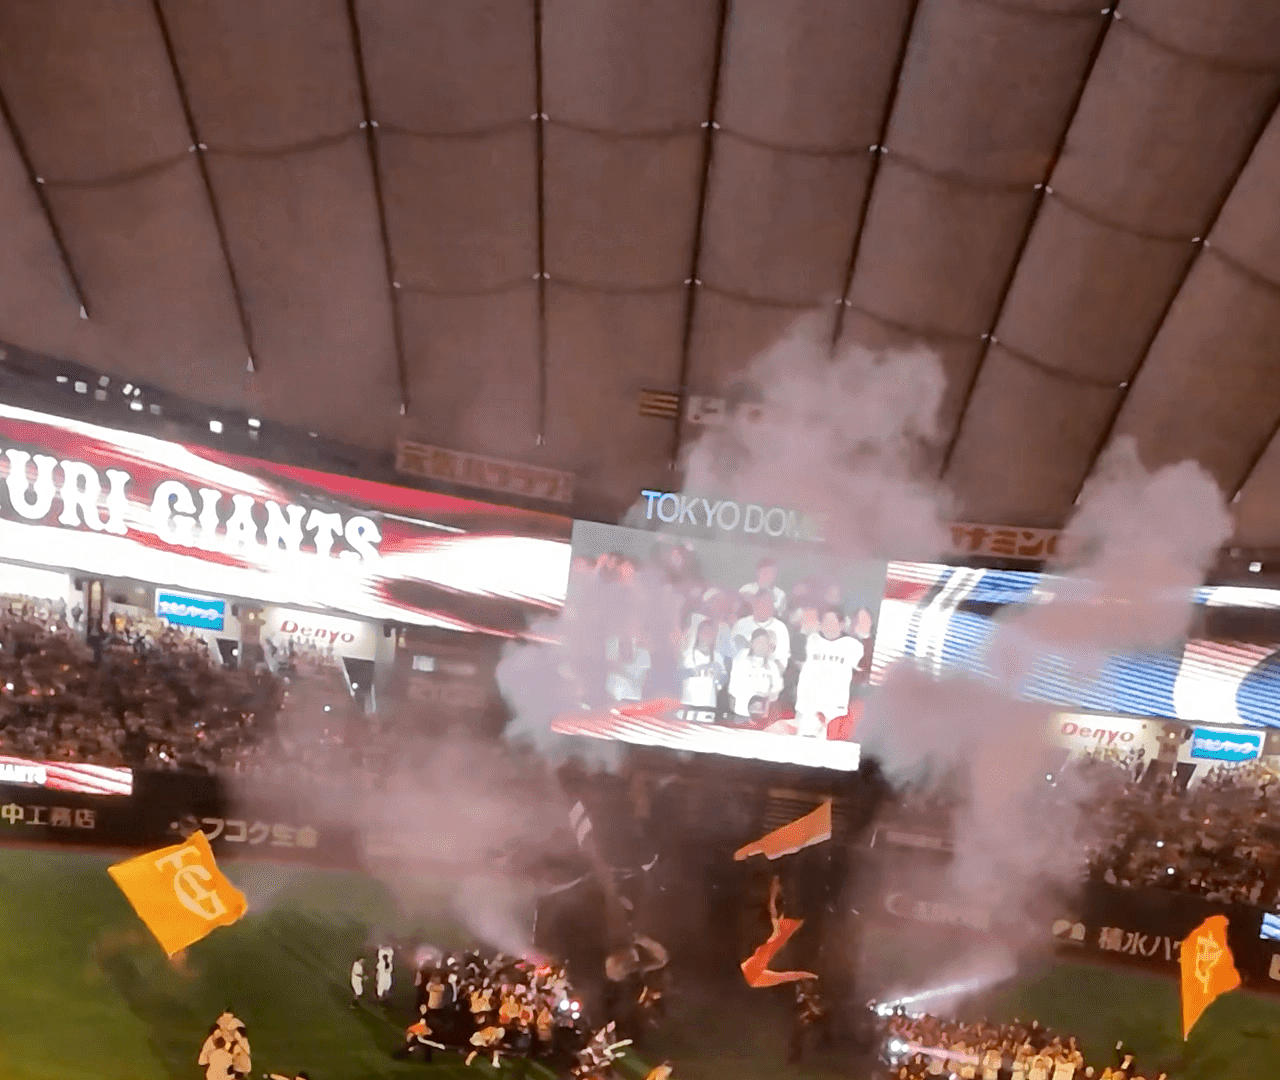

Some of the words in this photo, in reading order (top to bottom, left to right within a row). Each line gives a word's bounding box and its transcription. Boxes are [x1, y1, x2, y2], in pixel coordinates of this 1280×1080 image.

[150, 479, 384, 564] GIANTS
[641, 489, 740, 531] TOKYO
[280, 619, 356, 645] Denyo
[1060, 720, 1136, 744] Denyo
